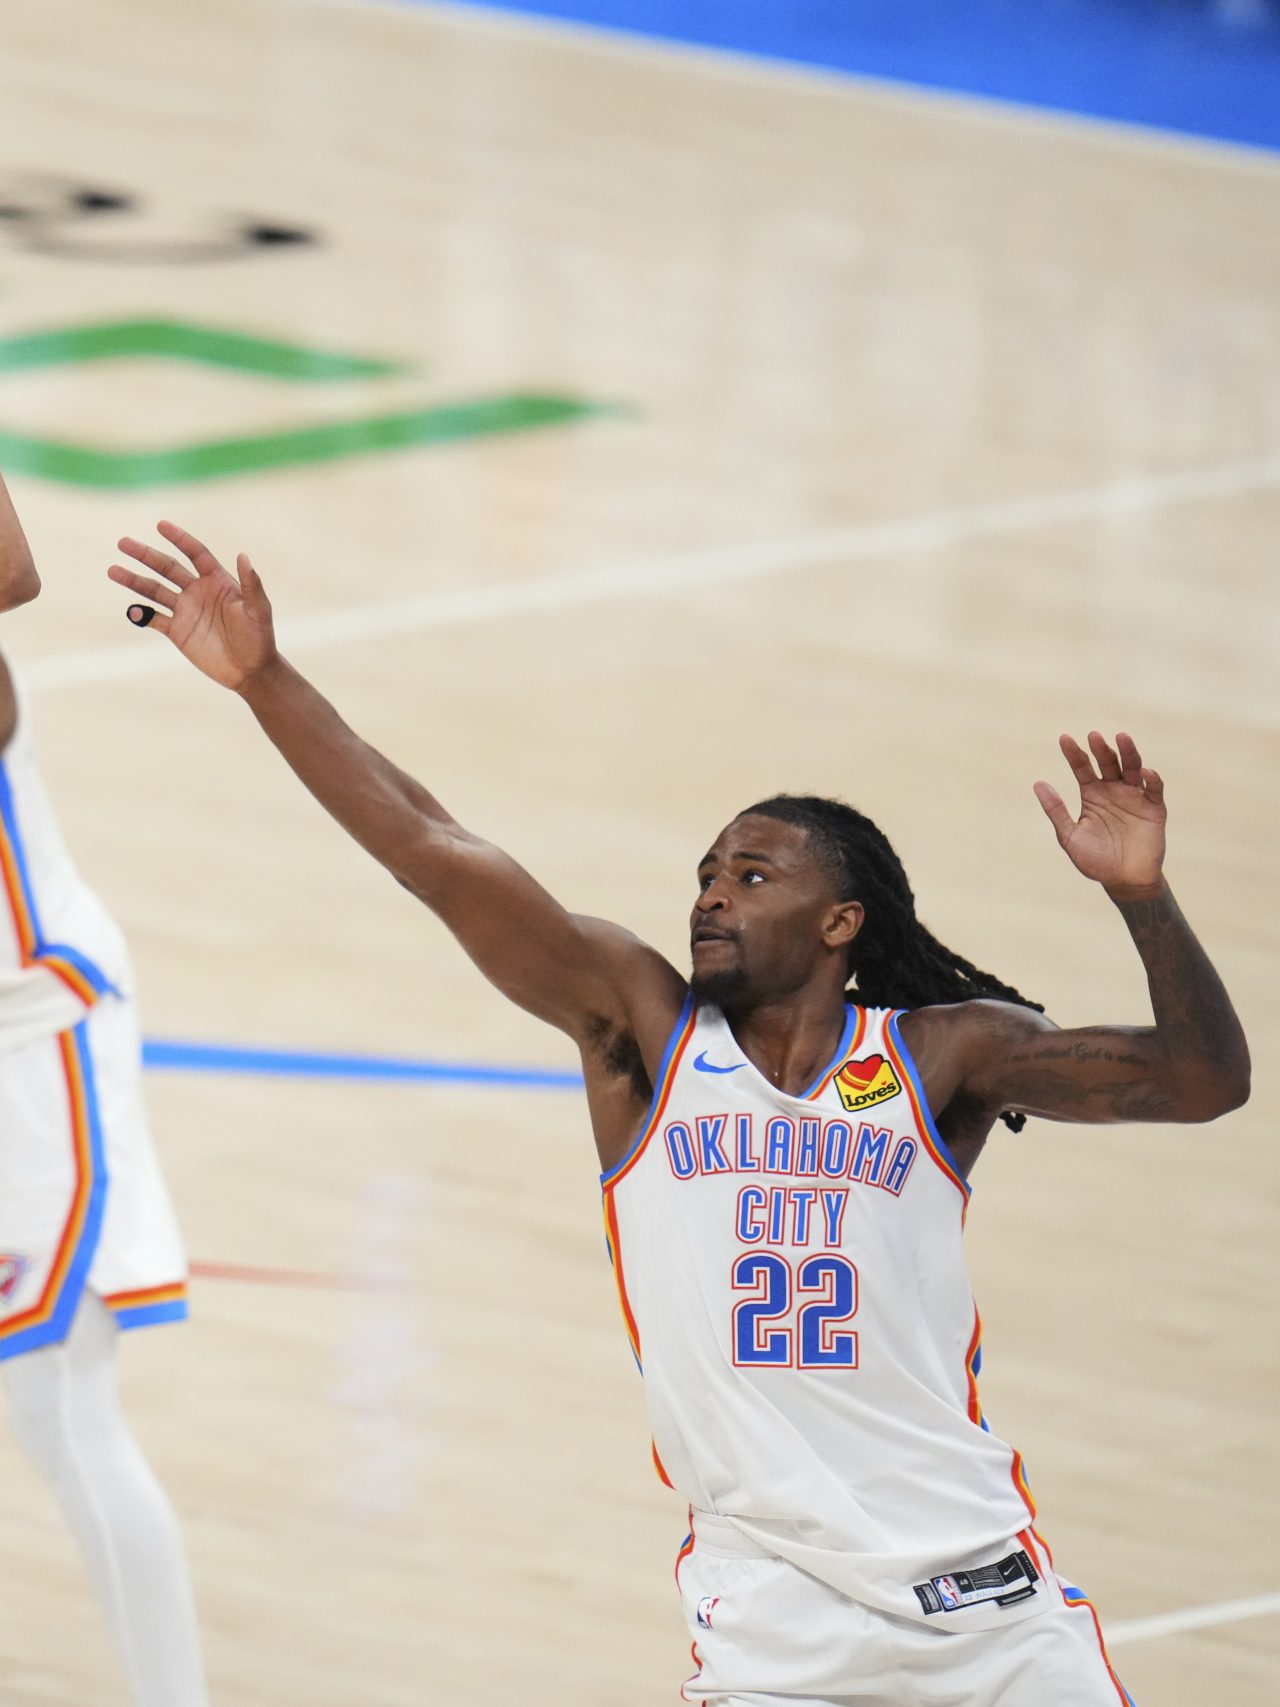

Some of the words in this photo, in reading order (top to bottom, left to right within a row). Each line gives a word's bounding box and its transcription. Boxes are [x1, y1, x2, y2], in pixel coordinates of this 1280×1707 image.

[664, 1113, 918, 1197] OKLAHOMA
[735, 1184, 850, 1248] CITY
[731, 1250, 859, 1370] 22
